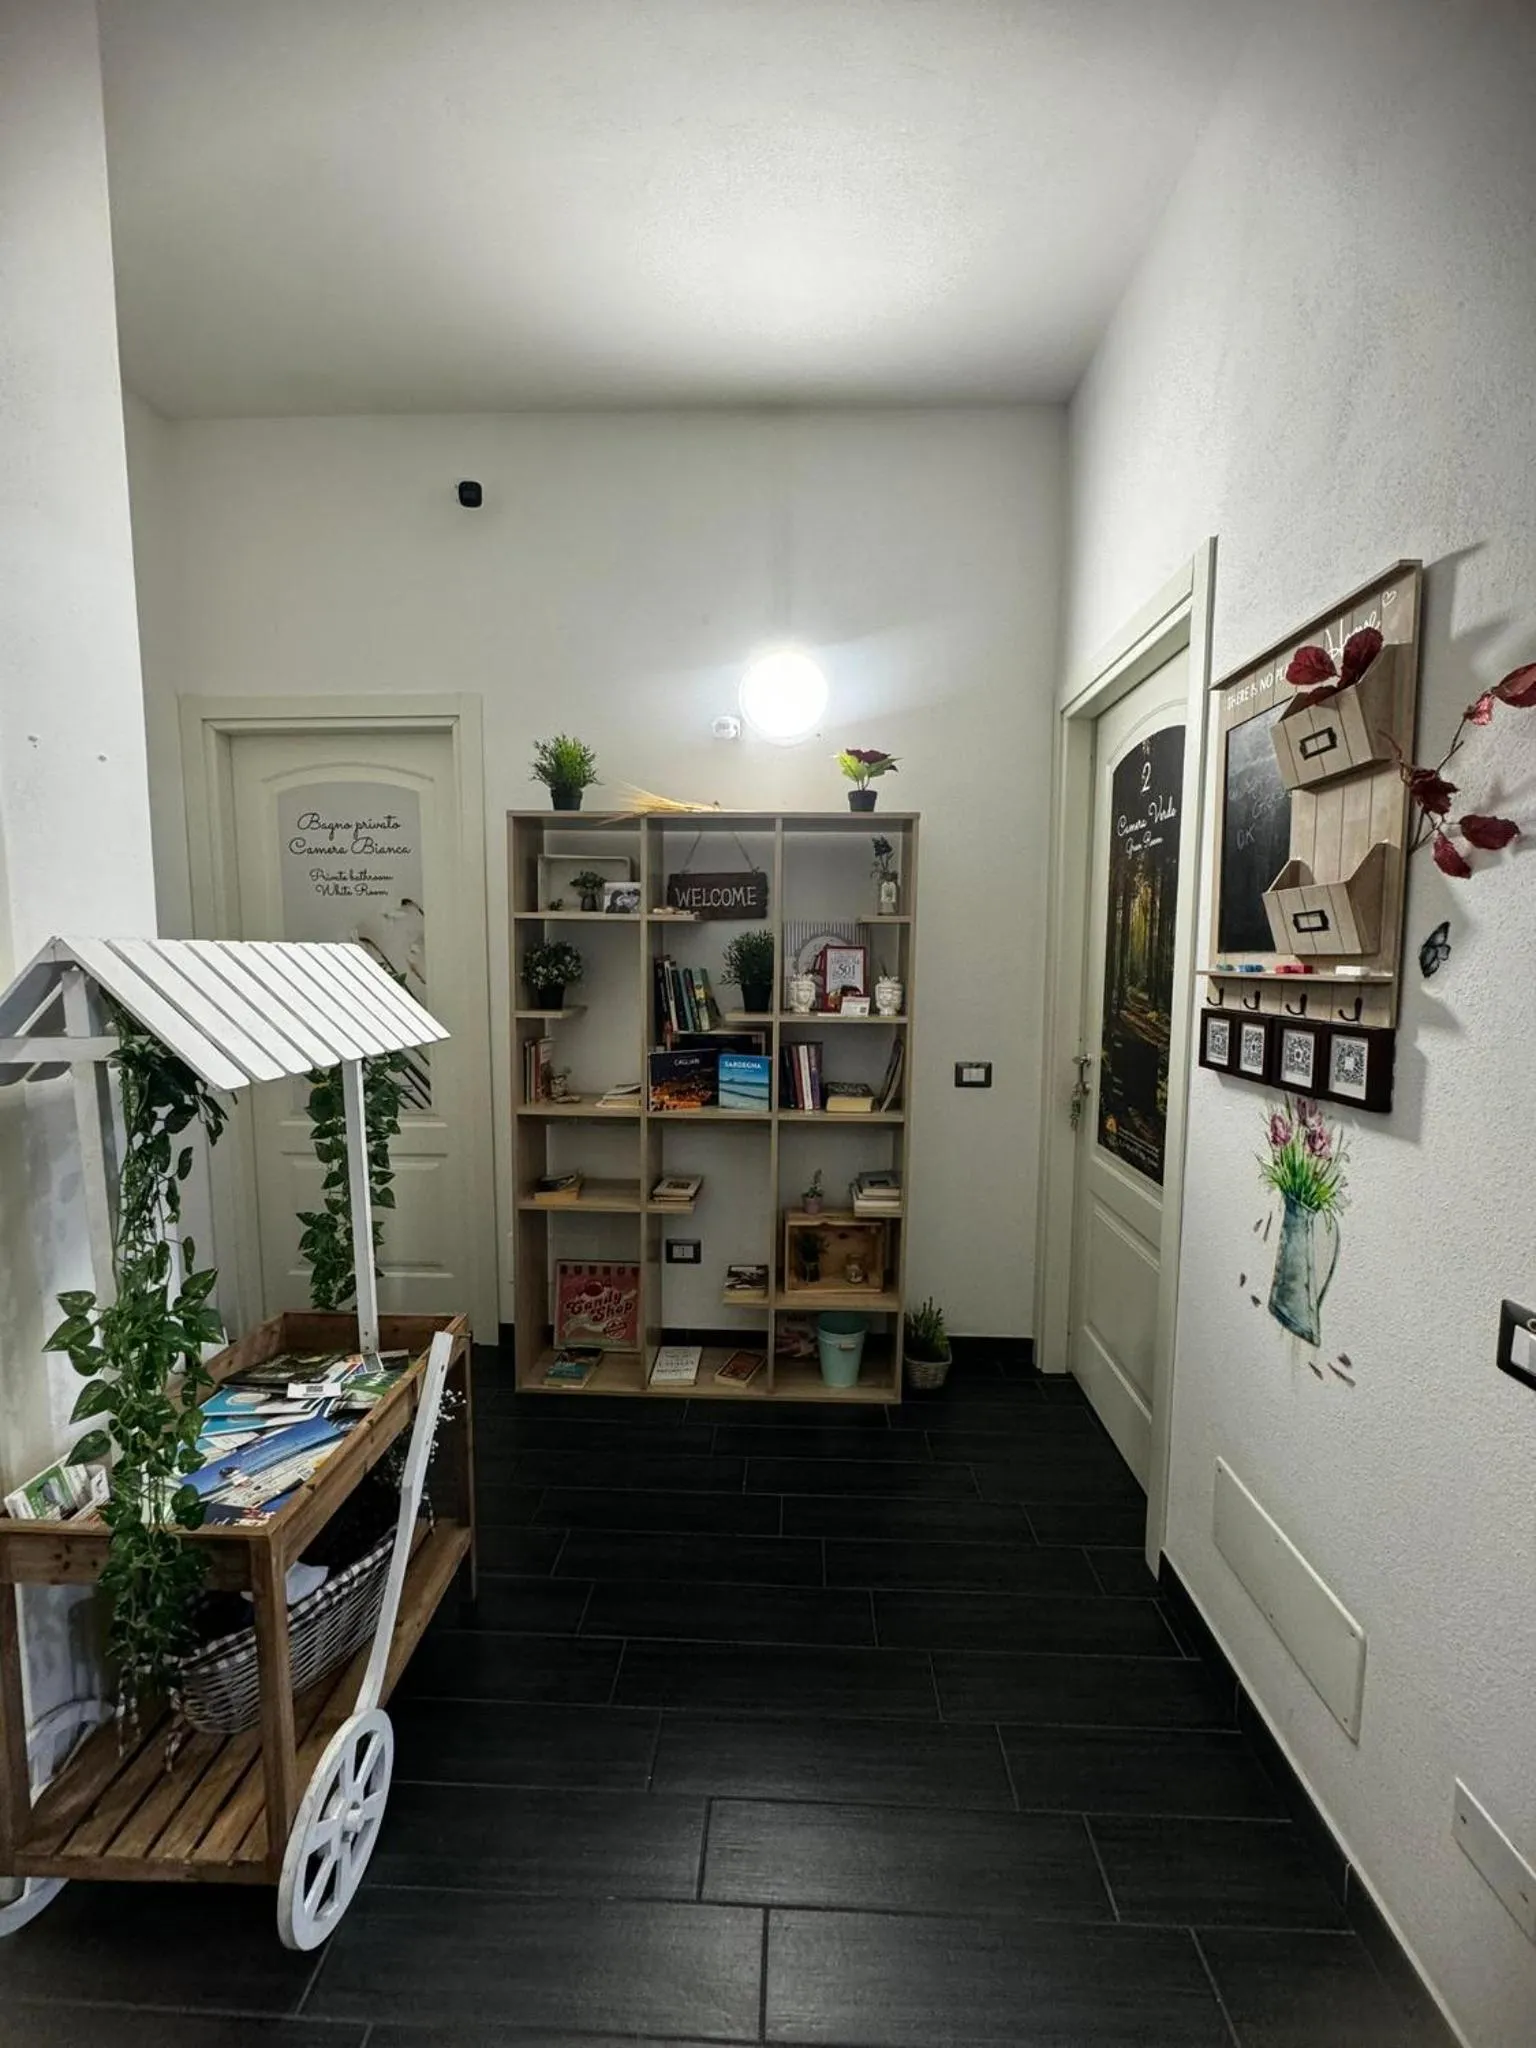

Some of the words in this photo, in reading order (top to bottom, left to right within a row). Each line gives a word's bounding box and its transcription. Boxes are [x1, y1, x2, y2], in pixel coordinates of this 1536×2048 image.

[1259, 672, 1274, 692] NO
[1140, 761, 1151, 792] 2
[1148, 795, 1177, 823] Verde
[297, 812, 352, 841] Bagno
[352, 814, 401, 840] privato
[288, 836, 348, 855] Camera
[350, 836, 411, 855] Bianca
[315, 884, 353, 896] White
[354, 882, 388, 896] Room
[675, 886, 757, 908] WELCOME
[724, 1060, 762, 1070] SARDEGNA
